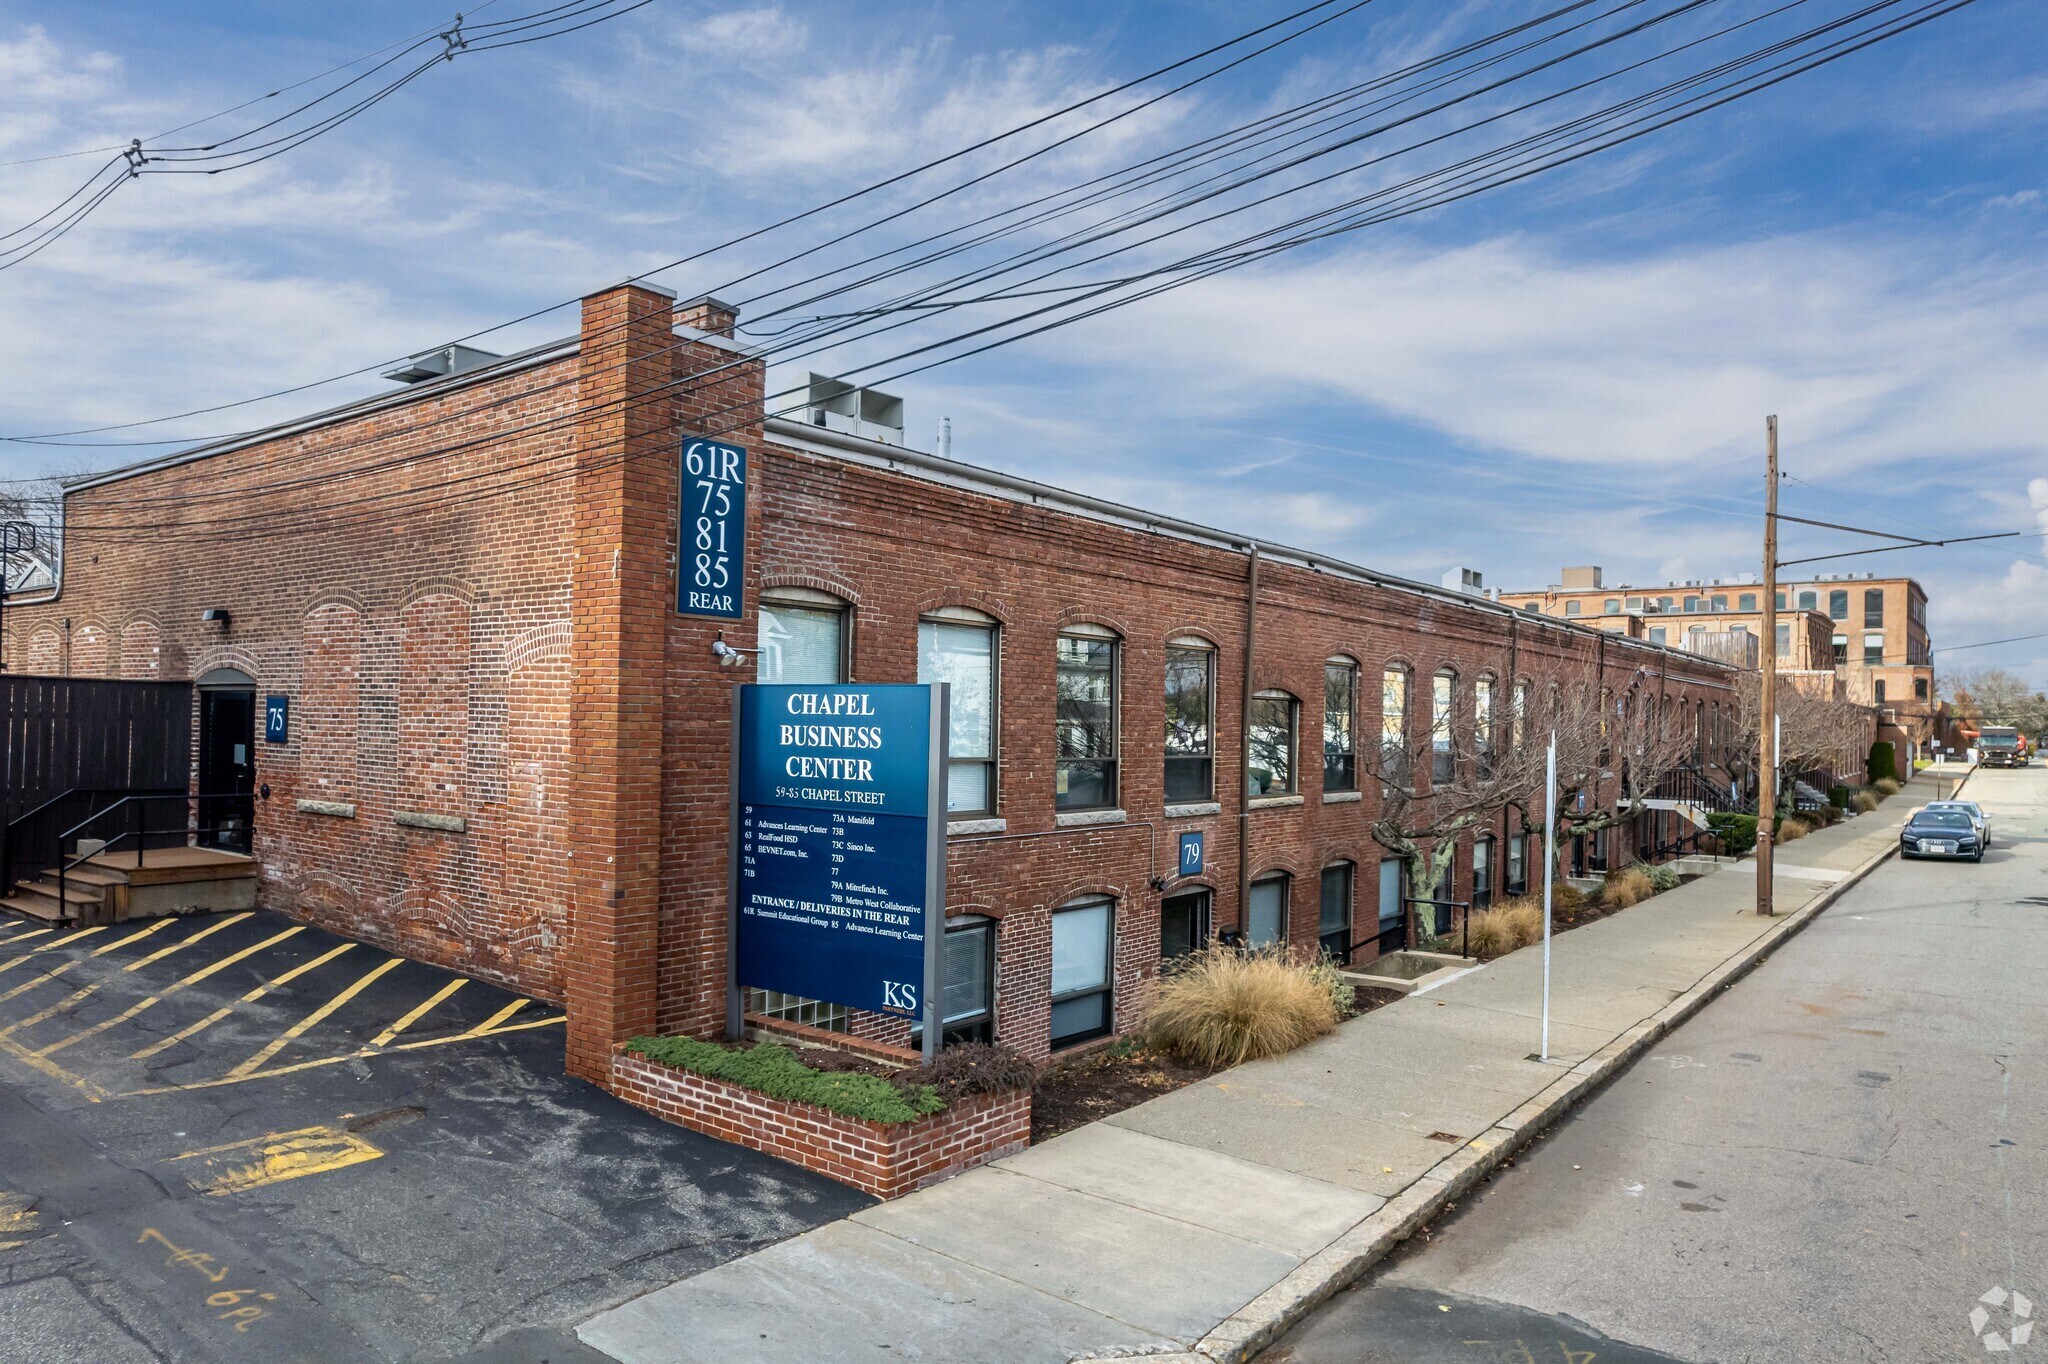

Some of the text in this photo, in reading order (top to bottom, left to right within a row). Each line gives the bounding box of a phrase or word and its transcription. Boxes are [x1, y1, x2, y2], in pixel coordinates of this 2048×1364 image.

[686, 443, 743, 484] 61R
[696, 480, 731, 516] 75
[696, 516, 727, 553] 81
[695, 553, 729, 588] 85
[689, 591, 734, 612] REAR
[787, 693, 875, 716] CHAPEL
[269, 708, 283, 731] 75
[780, 724, 882, 749] BUSINESS
[785, 756, 873, 781] CENTER
[801, 787, 842, 802] CHAPEL
[844, 790, 885, 805] STREET
[745, 805, 753, 814] 59
[832, 813, 875, 825] 73A Manifold
[744, 819, 828, 834] 61 Advances Learning Center
[832, 827, 844, 836] 73B
[744, 831, 752, 839] 63
[784, 834, 798, 844] HSD
[831, 840, 876, 853] 73C Sinco Inc.
[744, 843, 752, 852] 65
[798, 849, 809, 858] Inc.
[744, 856, 756, 865] 71A
[831, 853, 845, 863] 73D
[1184, 842, 1200, 865] 79
[743, 868, 756, 878] 71B
[831, 867, 839, 876] 77
[831, 880, 889, 896] 79A Mitrefinch Inc.
[751, 894, 795, 909] ENTRANCE
[800, 901, 851, 917] DELIVERIES
[852, 908, 863, 919] IN
[863, 909, 883, 922] THE
[884, 913, 910, 926] REAR
[830, 893, 921, 914] 79B Metro West Collaborative
[743, 906, 829, 928] 61R Summit Educational Group
[831, 920, 924, 942] 85 Advances Learning Center
[882, 980, 917, 1010] KS
